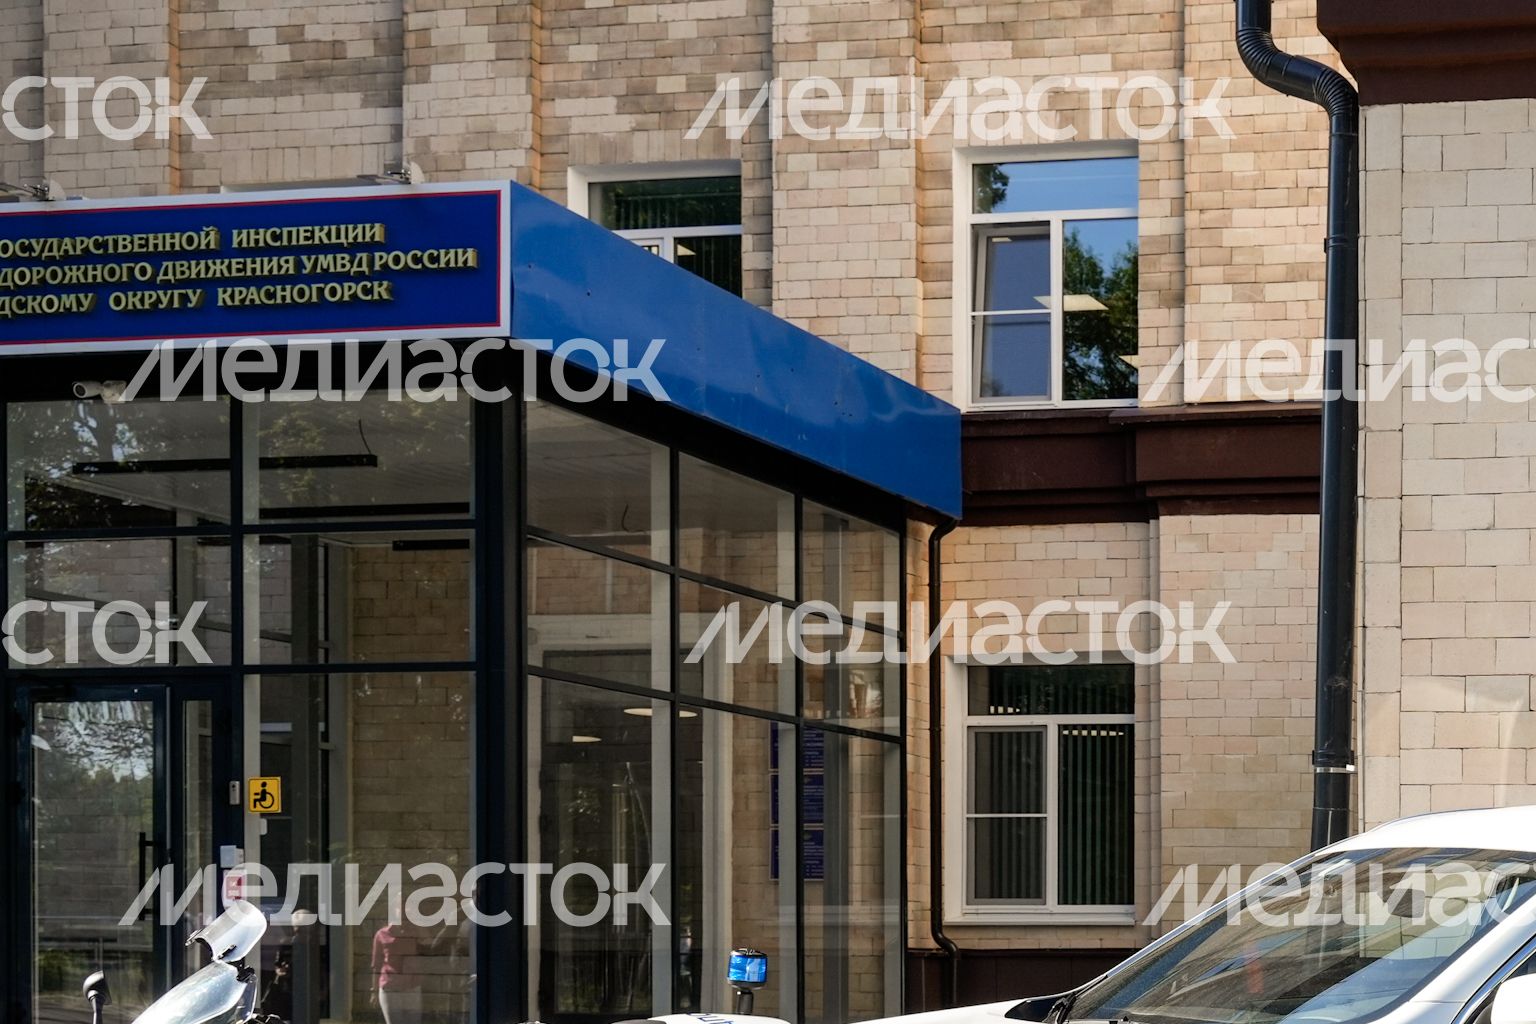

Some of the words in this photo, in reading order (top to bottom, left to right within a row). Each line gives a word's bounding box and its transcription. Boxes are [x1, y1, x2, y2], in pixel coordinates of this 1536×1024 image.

[0, 226, 219, 260] ОСУДАРСТВЕННОЙ
[232, 223, 385, 248] ИНСПЕКЦИИ
[0, 262, 152, 289] ДОРОЖНОГО
[157, 256, 296, 284] ДВИЖЕНИЯ
[301, 252, 372, 277] УМВД
[374, 248, 478, 271] РОССИИ
[109, 288, 203, 311] ОКРУГУ
[217, 280, 393, 307] КРАСНОГОРСК
